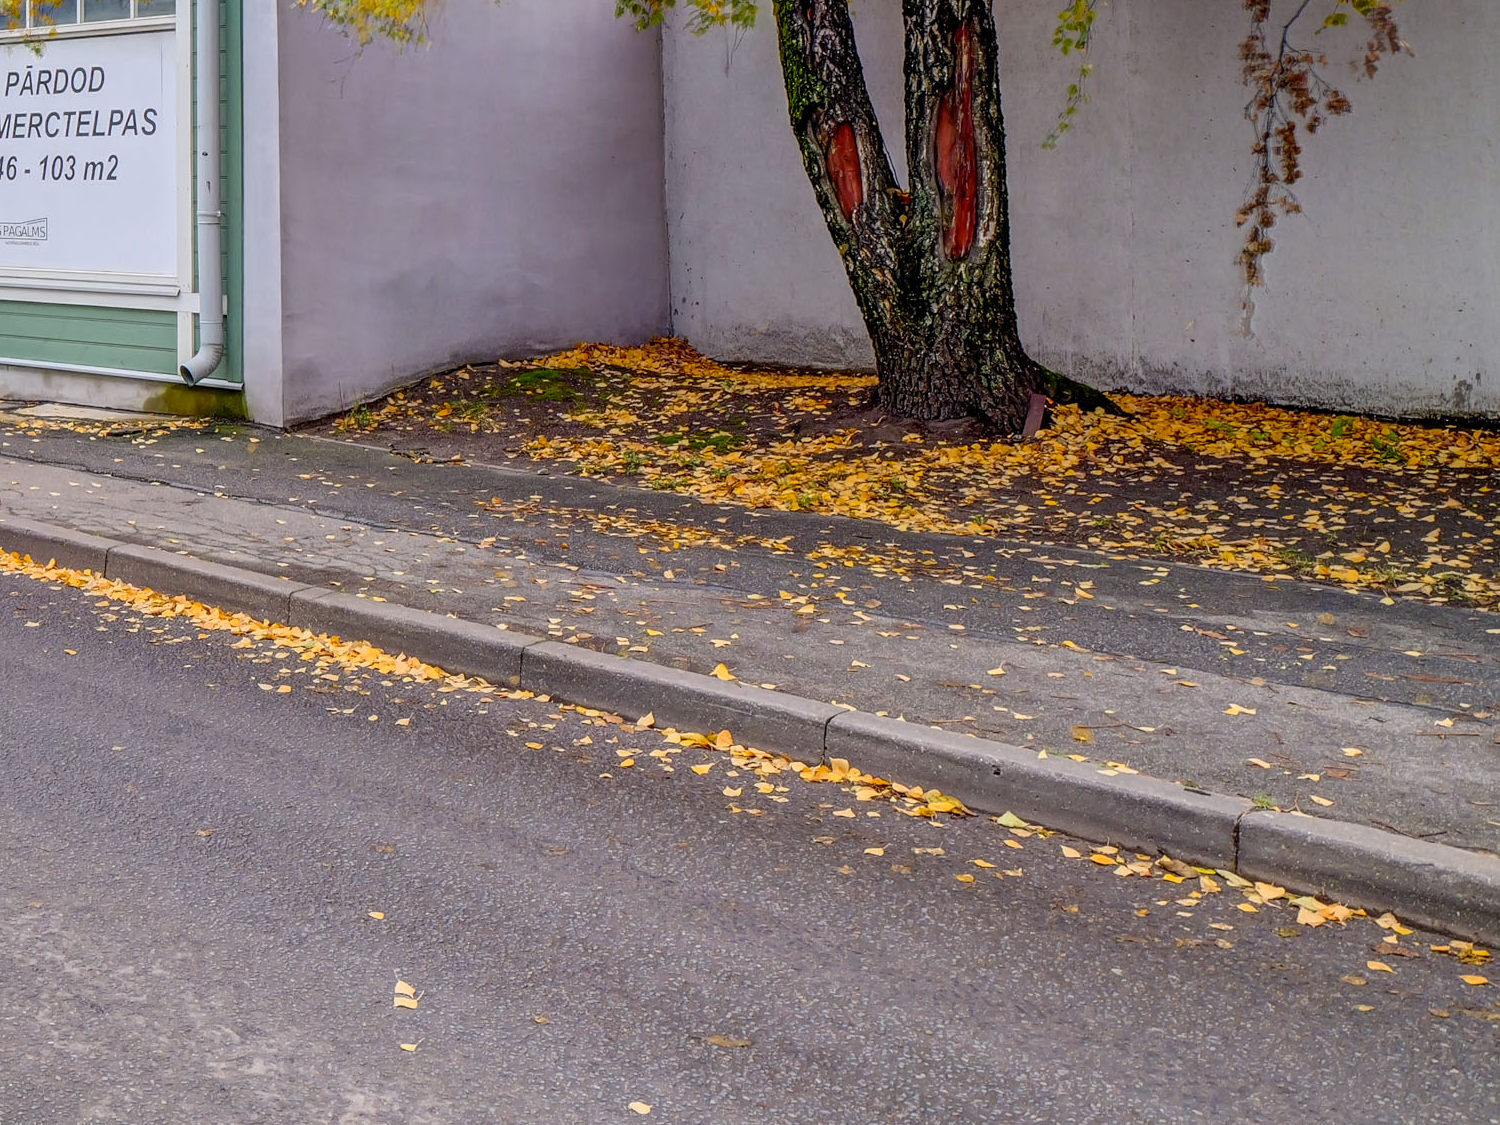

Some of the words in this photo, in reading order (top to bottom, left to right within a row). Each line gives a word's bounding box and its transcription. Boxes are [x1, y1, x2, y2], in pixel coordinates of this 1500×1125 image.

[5, 65, 105, 96] PĀRDOD
[39, 155, 76, 180] 103
[83, 155, 119, 180] m2
[3, 225, 46, 237] PAGALMS
